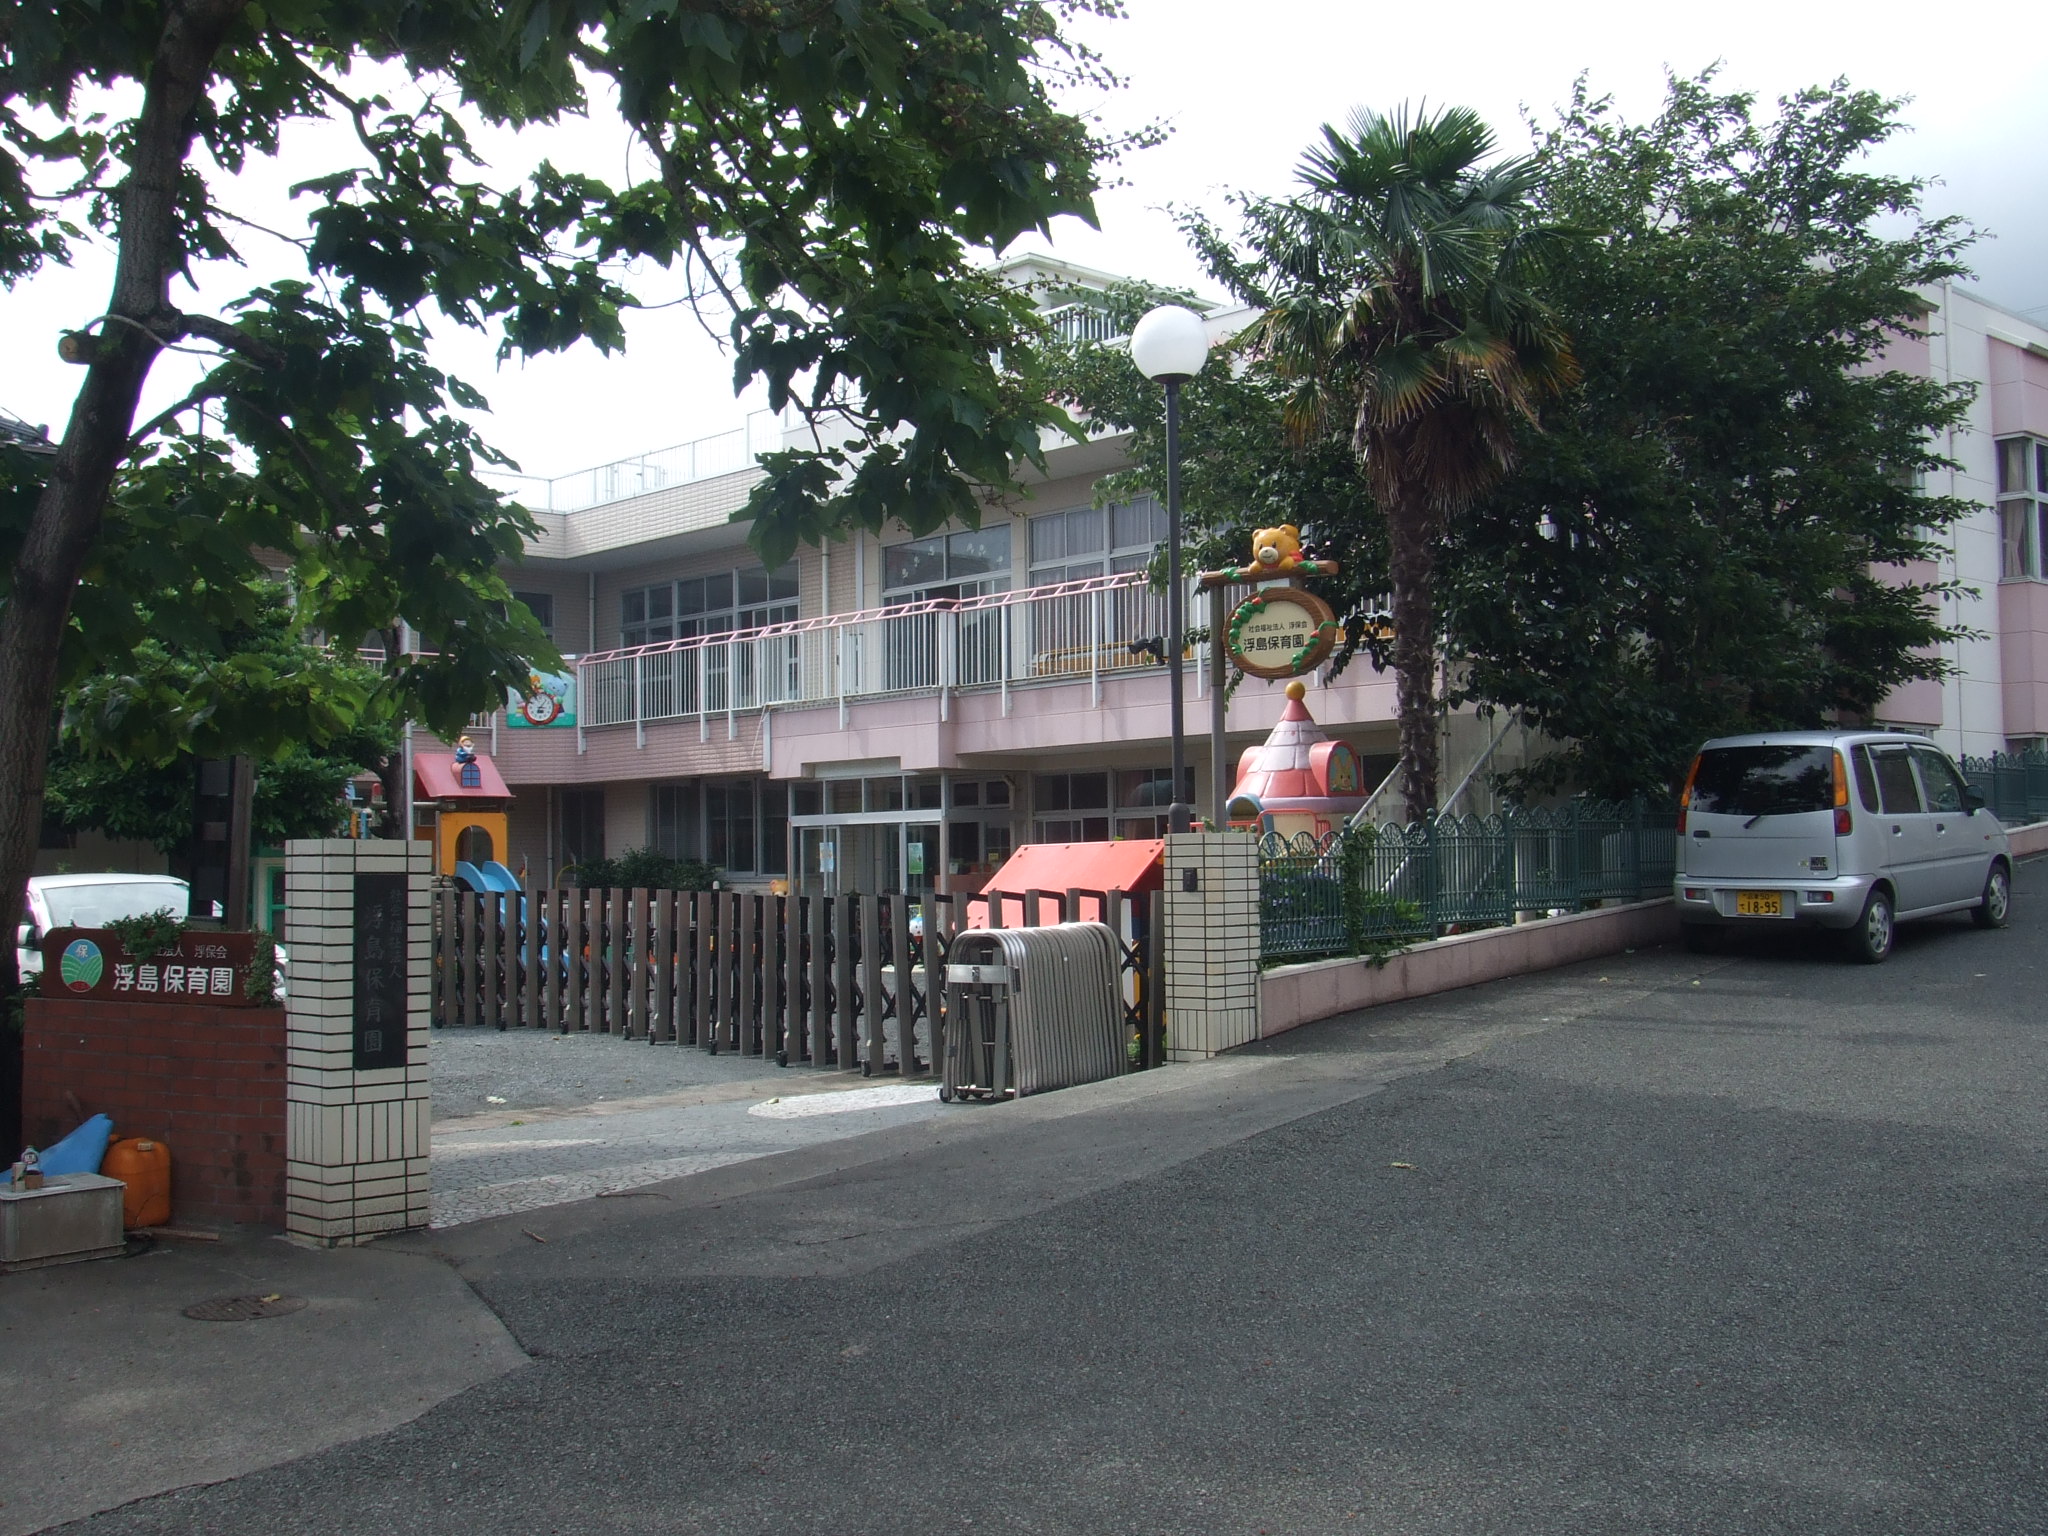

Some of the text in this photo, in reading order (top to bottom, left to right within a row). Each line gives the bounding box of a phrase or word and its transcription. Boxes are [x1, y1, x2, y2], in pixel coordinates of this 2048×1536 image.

[1244, 633, 1305, 652] 浮島保育園
[1747, 901, 1778, 914] 18-95
[75, 944, 88, 958] 保
[194, 944, 228, 959] 浮保会
[113, 963, 234, 996] 浮島保育園
[363, 904, 385, 1054] 浮島保育園
